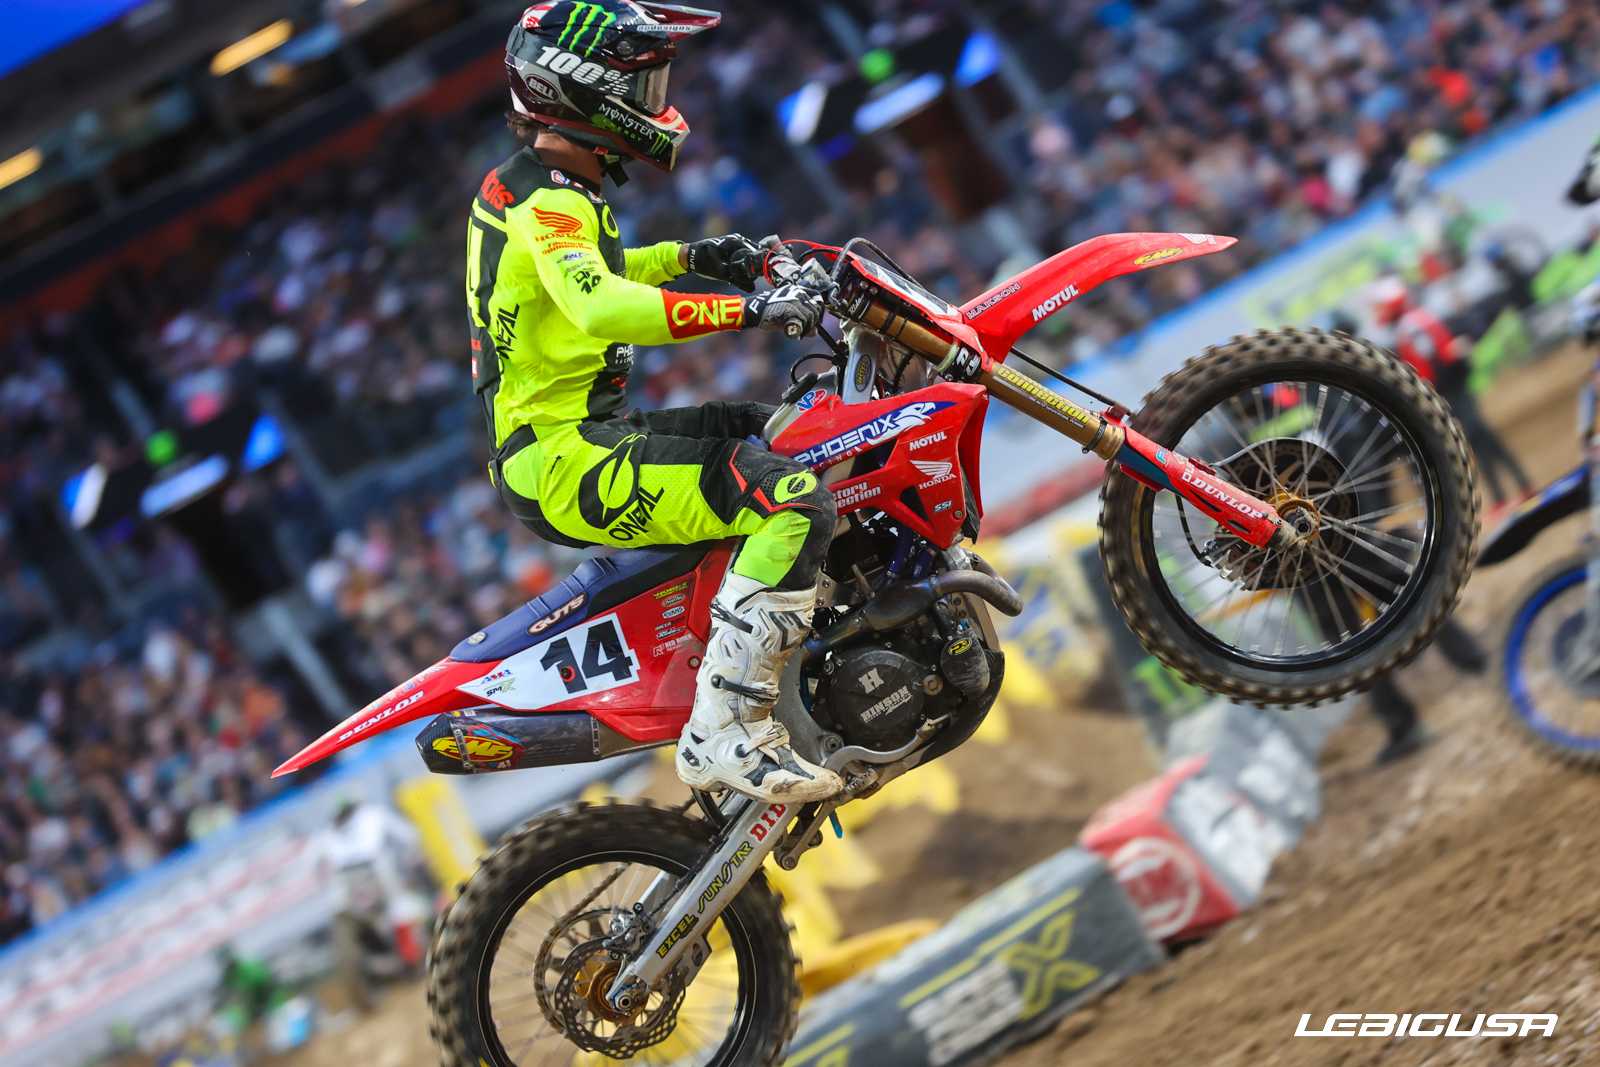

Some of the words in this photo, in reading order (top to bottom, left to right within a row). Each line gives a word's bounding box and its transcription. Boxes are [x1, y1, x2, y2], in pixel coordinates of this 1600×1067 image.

[535, 45, 634, 96] 100%
[528, 77, 555, 100] BELL
[598, 103, 655, 140] MONSTER
[602, 118, 642, 142] ENERGY
[534, 232, 587, 243] HONDA
[965, 282, 1022, 320] MAKSON
[1031, 284, 1080, 321] MOTUL
[796, 391, 816, 409] VP
[792, 414, 896, 465] PHOENIX
[909, 431, 948, 451] MOTUL
[918, 472, 957, 490] HONDA
[934, 499, 952, 513] SSI
[1190, 477, 1264, 519] DUNLOP
[528, 593, 585, 634] GUTS
[663, 606, 684, 618] EVANS
[664, 639, 676, 648] RED
[675, 633, 693, 643] RIDER
[539, 619, 634, 694] 14
[480, 669, 513, 685] AMA
[486, 678, 517, 697] SMX
[857, 667, 885, 694] H
[336, 690, 425, 744] DUNLOP
[860, 685, 909, 722] HINSON
[431, 738, 514, 758] FMF
[698, 841, 754, 914] SUNSTAR
[656, 914, 697, 959] EXCEL
